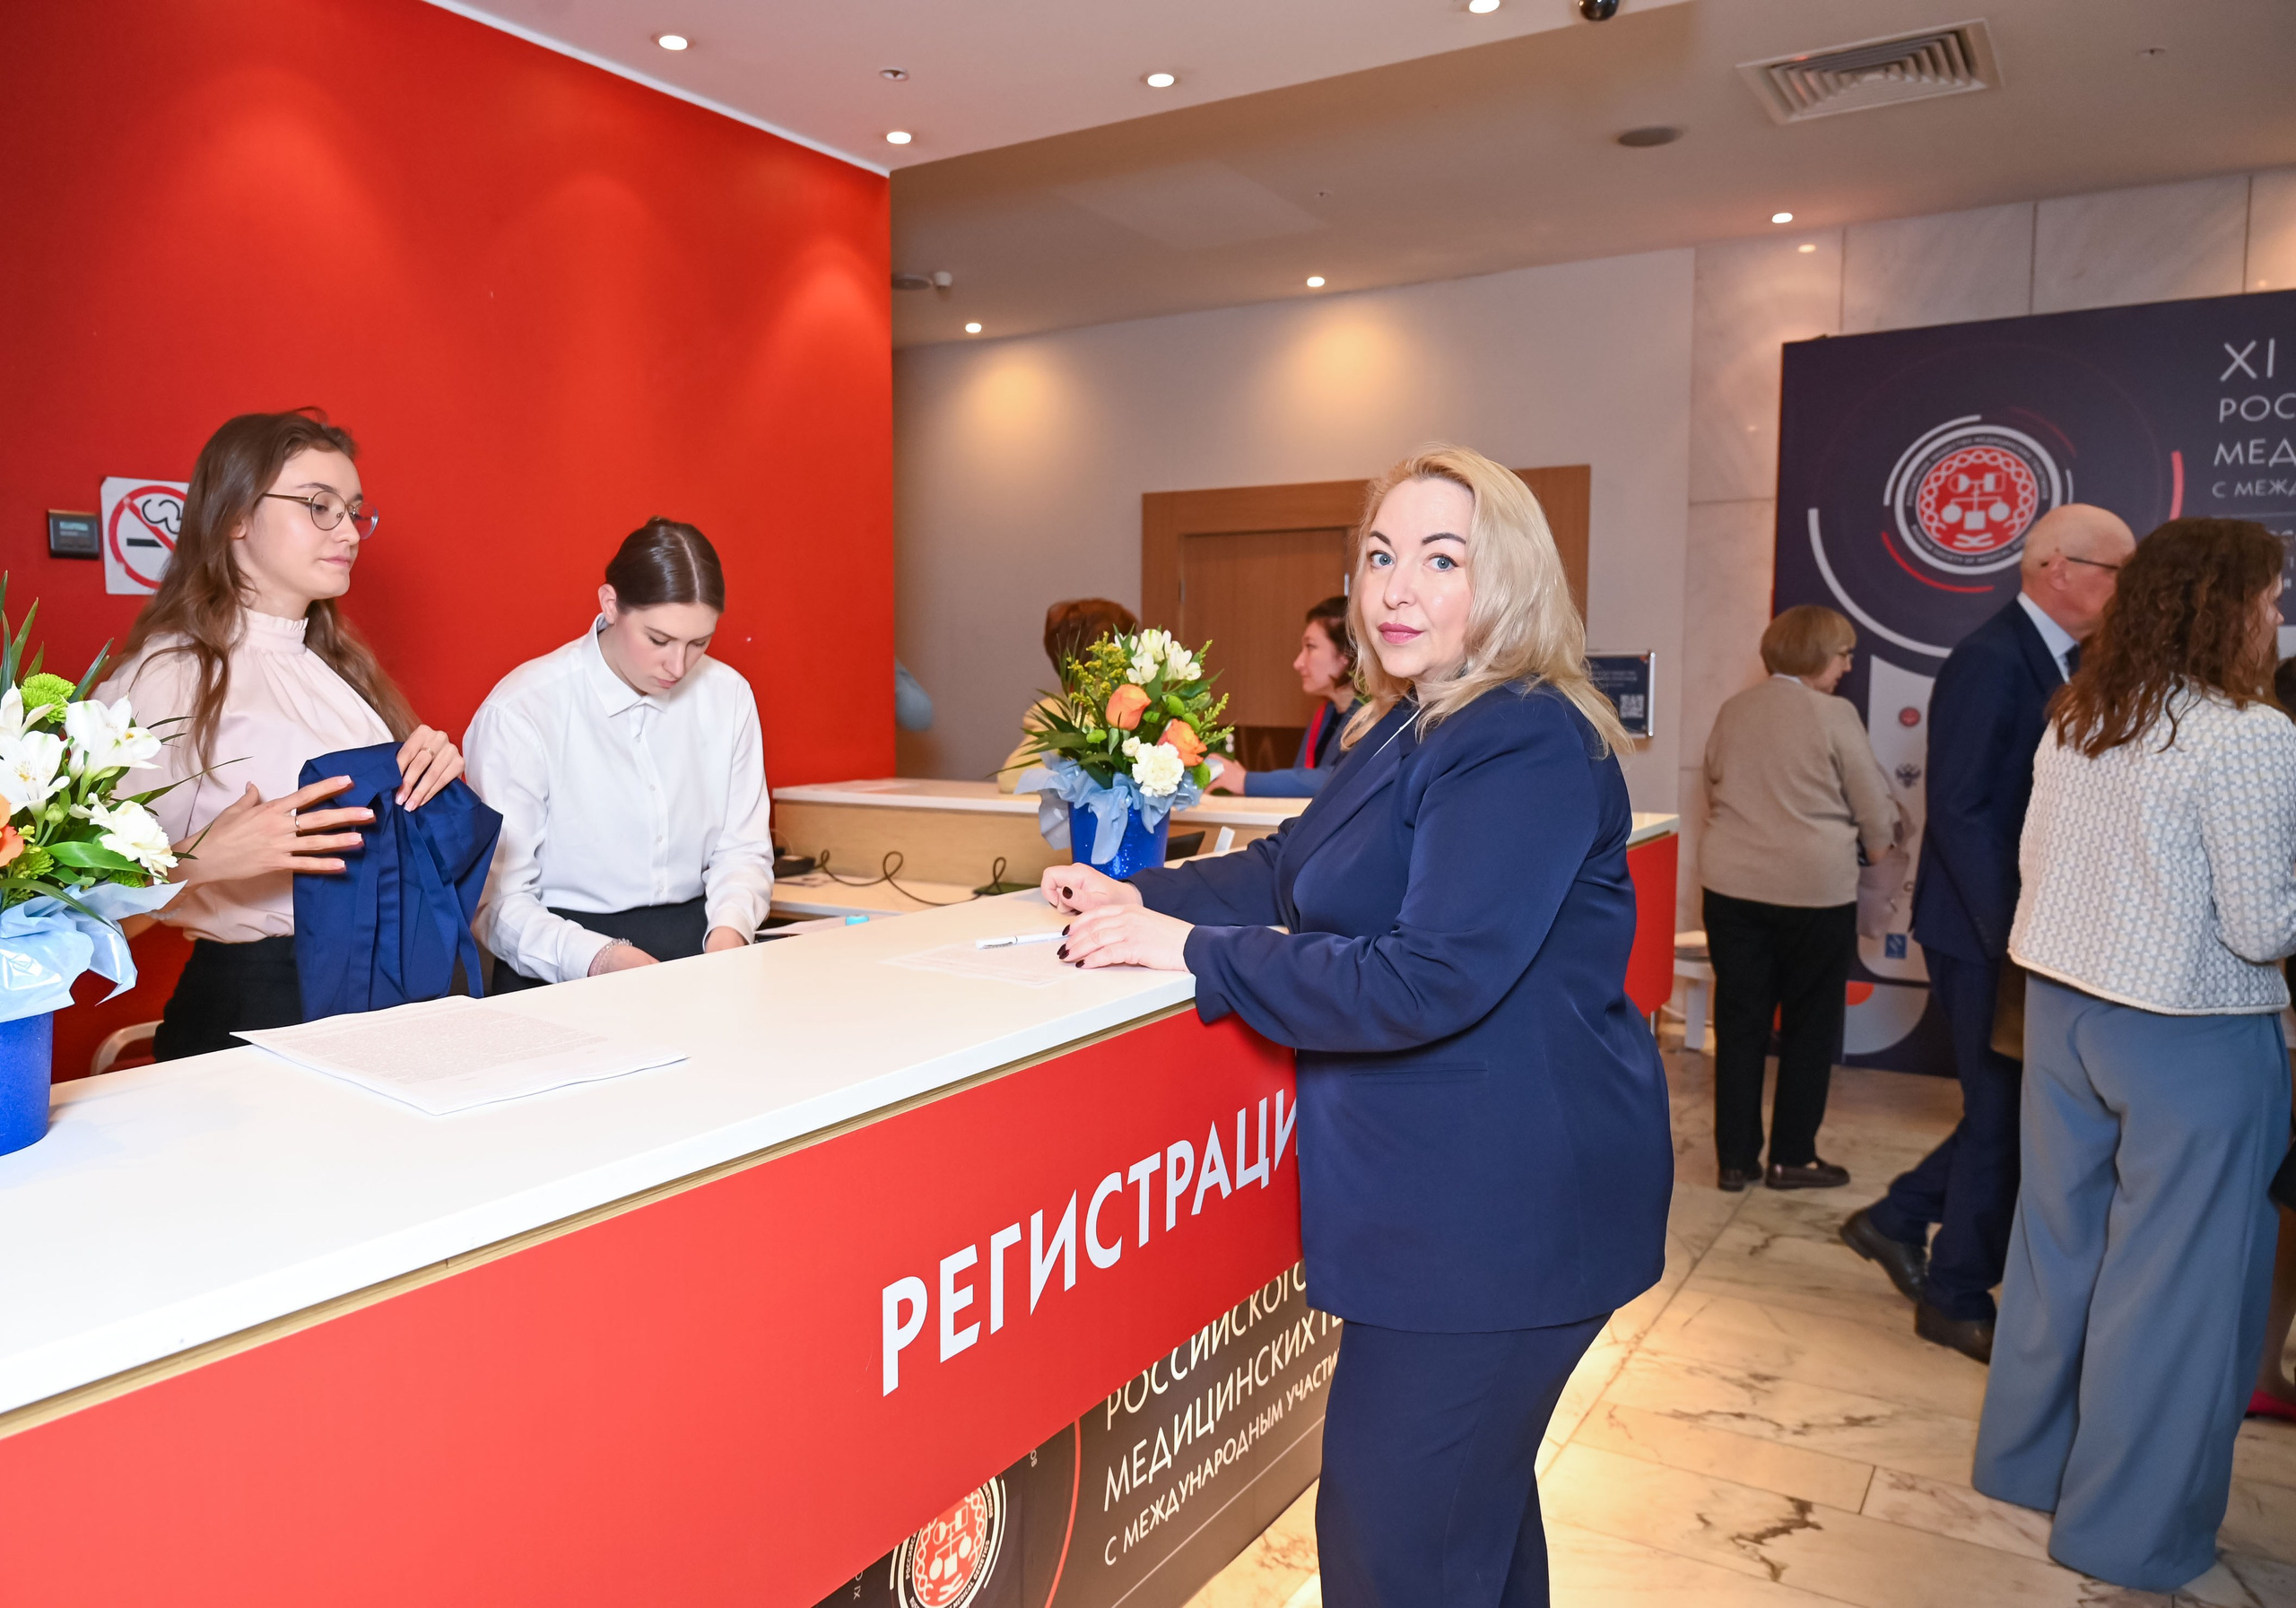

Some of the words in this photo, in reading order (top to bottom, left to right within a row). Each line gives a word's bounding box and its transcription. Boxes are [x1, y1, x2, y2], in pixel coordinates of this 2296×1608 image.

[2220, 338, 2274, 381] XI
[2219, 392, 2296, 424] РОС
[2213, 437, 2296, 468] МЕД
[2212, 480, 2226, 499] С
[882, 1088, 1298, 1397] РЕГИСТРАЦИ
[1104, 1309, 1316, 1512] МЕДИЦИНСКИХ
[1104, 1535, 1118, 1566] С
[1123, 1397, 1283, 1553] МЕЖДУНАРОДНЫМ
[1286, 1347, 1340, 1412] УЧАСТИ
[973, 1539, 990, 1580] GENETICS
